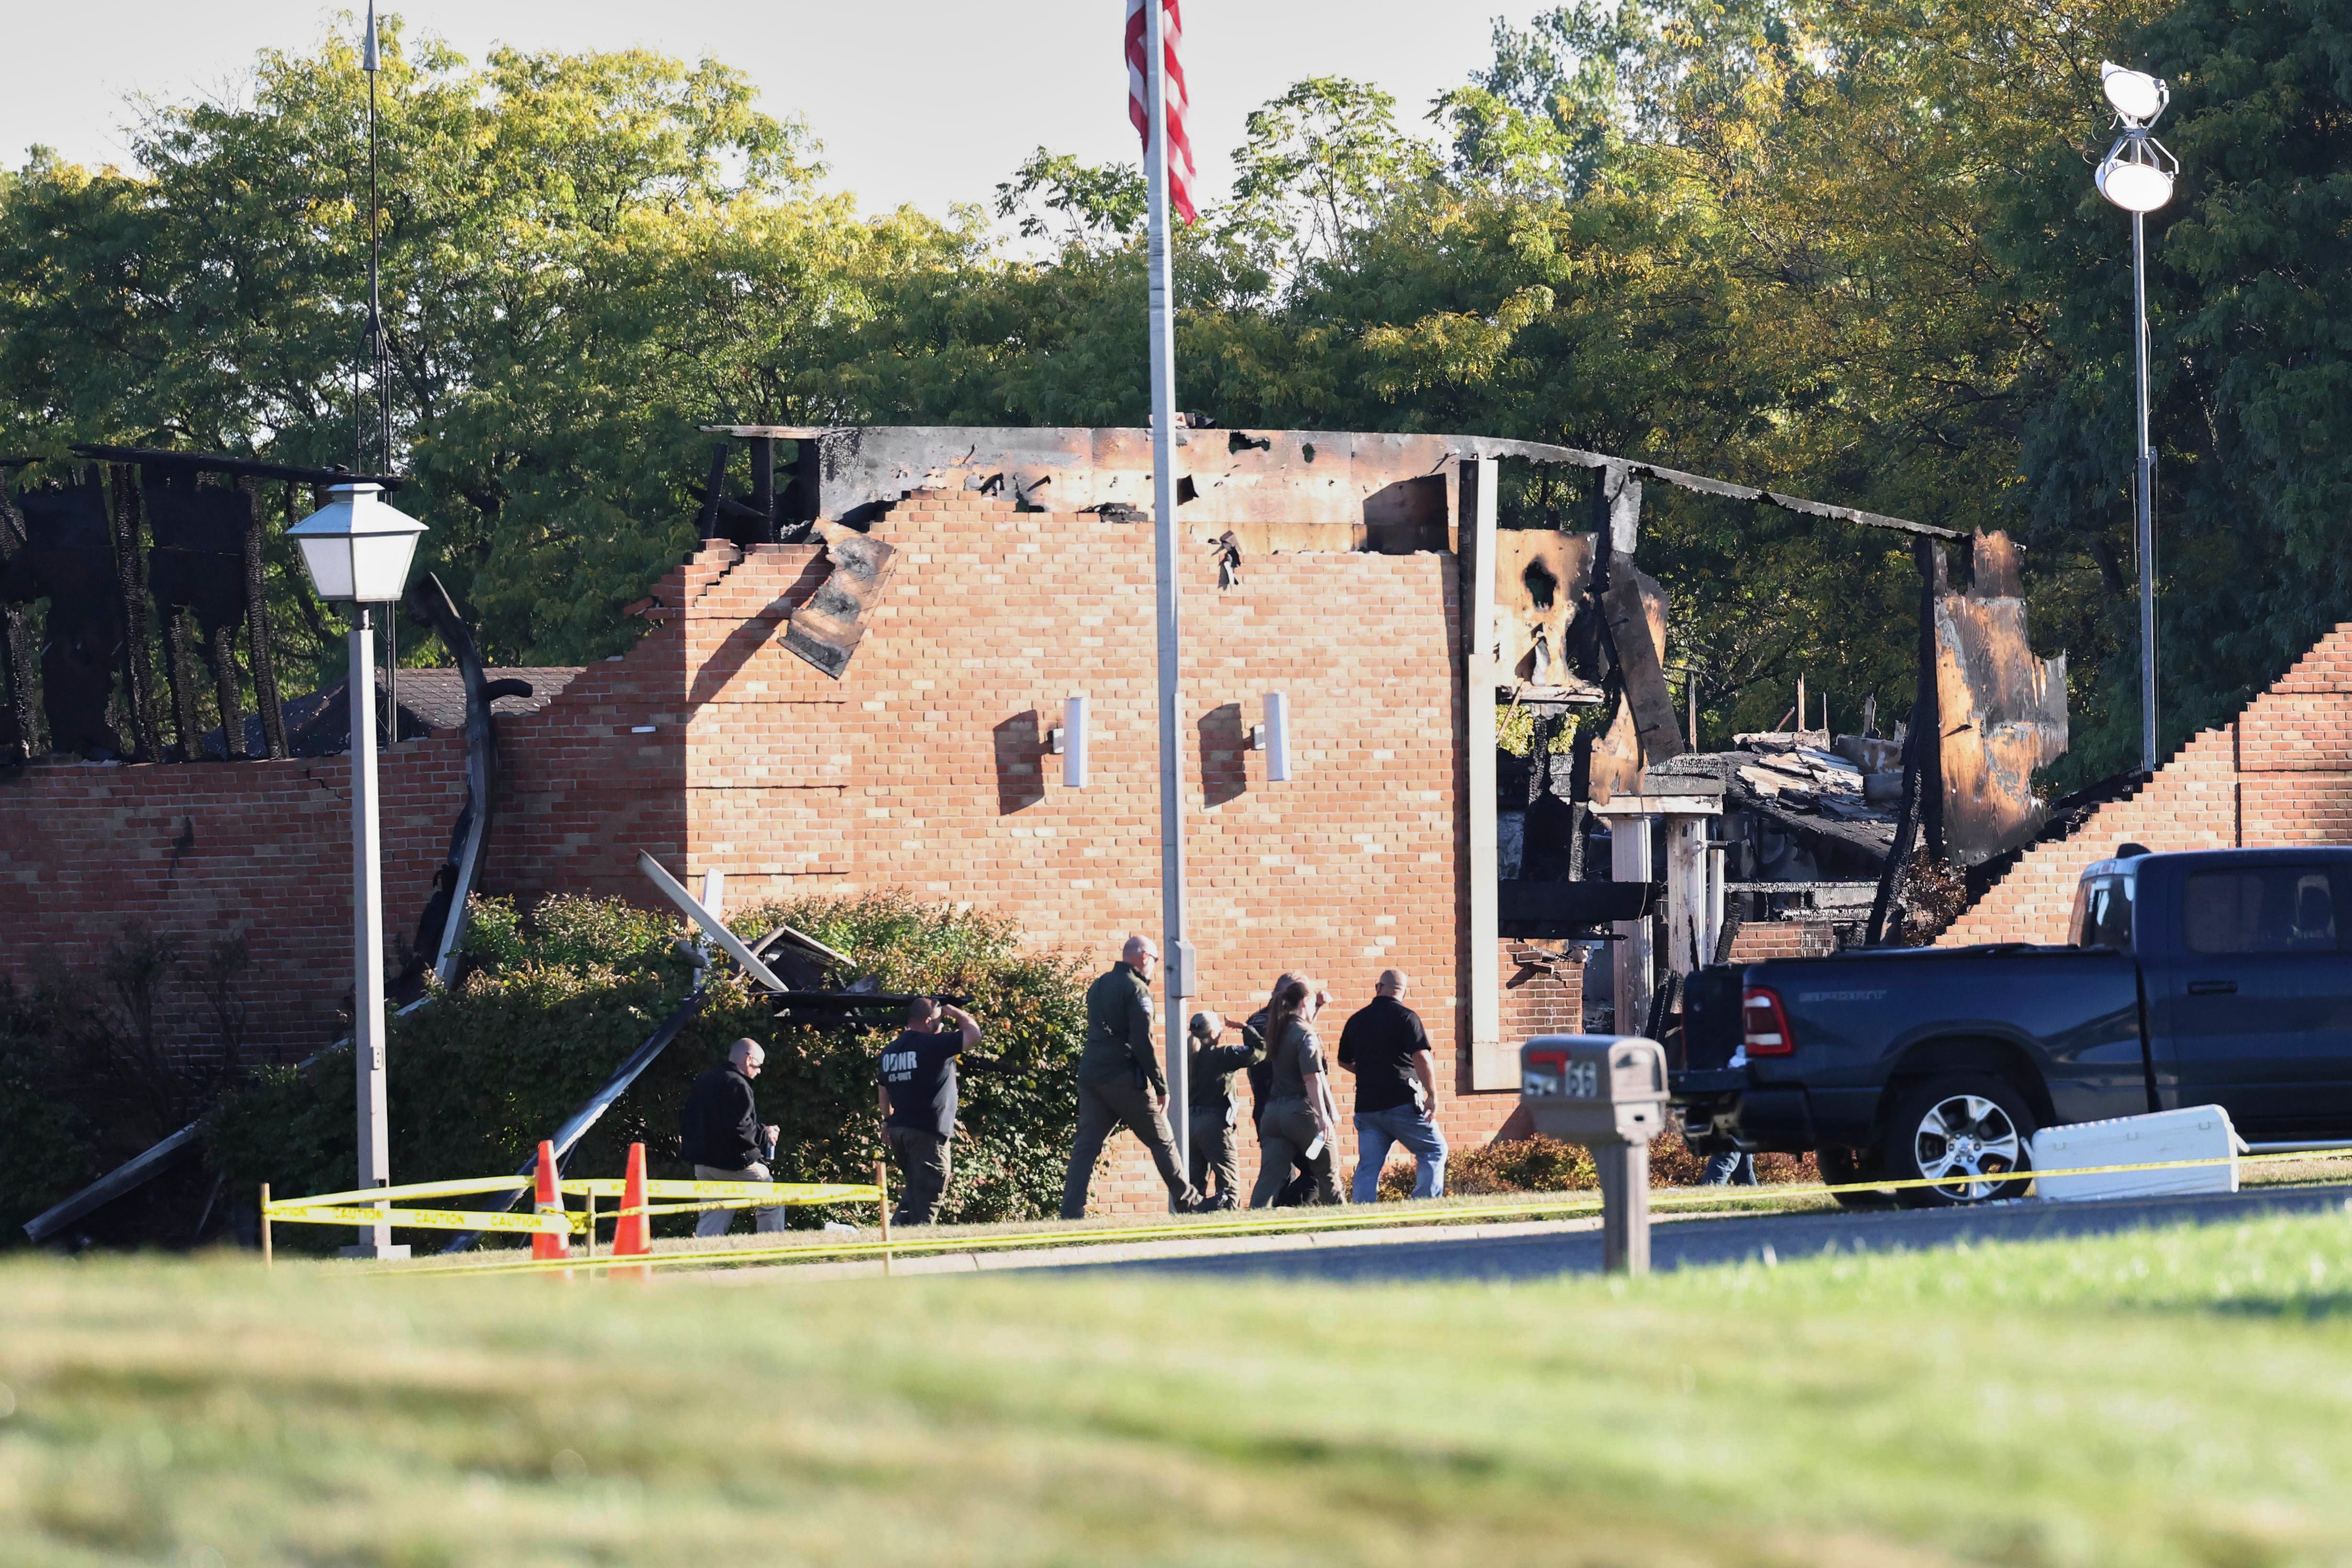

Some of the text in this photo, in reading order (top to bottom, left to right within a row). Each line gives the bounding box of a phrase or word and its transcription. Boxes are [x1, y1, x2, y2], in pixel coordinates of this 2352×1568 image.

[882, 1051, 917, 1072] ODNR
[332, 1207, 384, 1220] CAUTION
[414, 1212, 465, 1225] CAUTION
[490, 1215, 543, 1227] CAUTION
